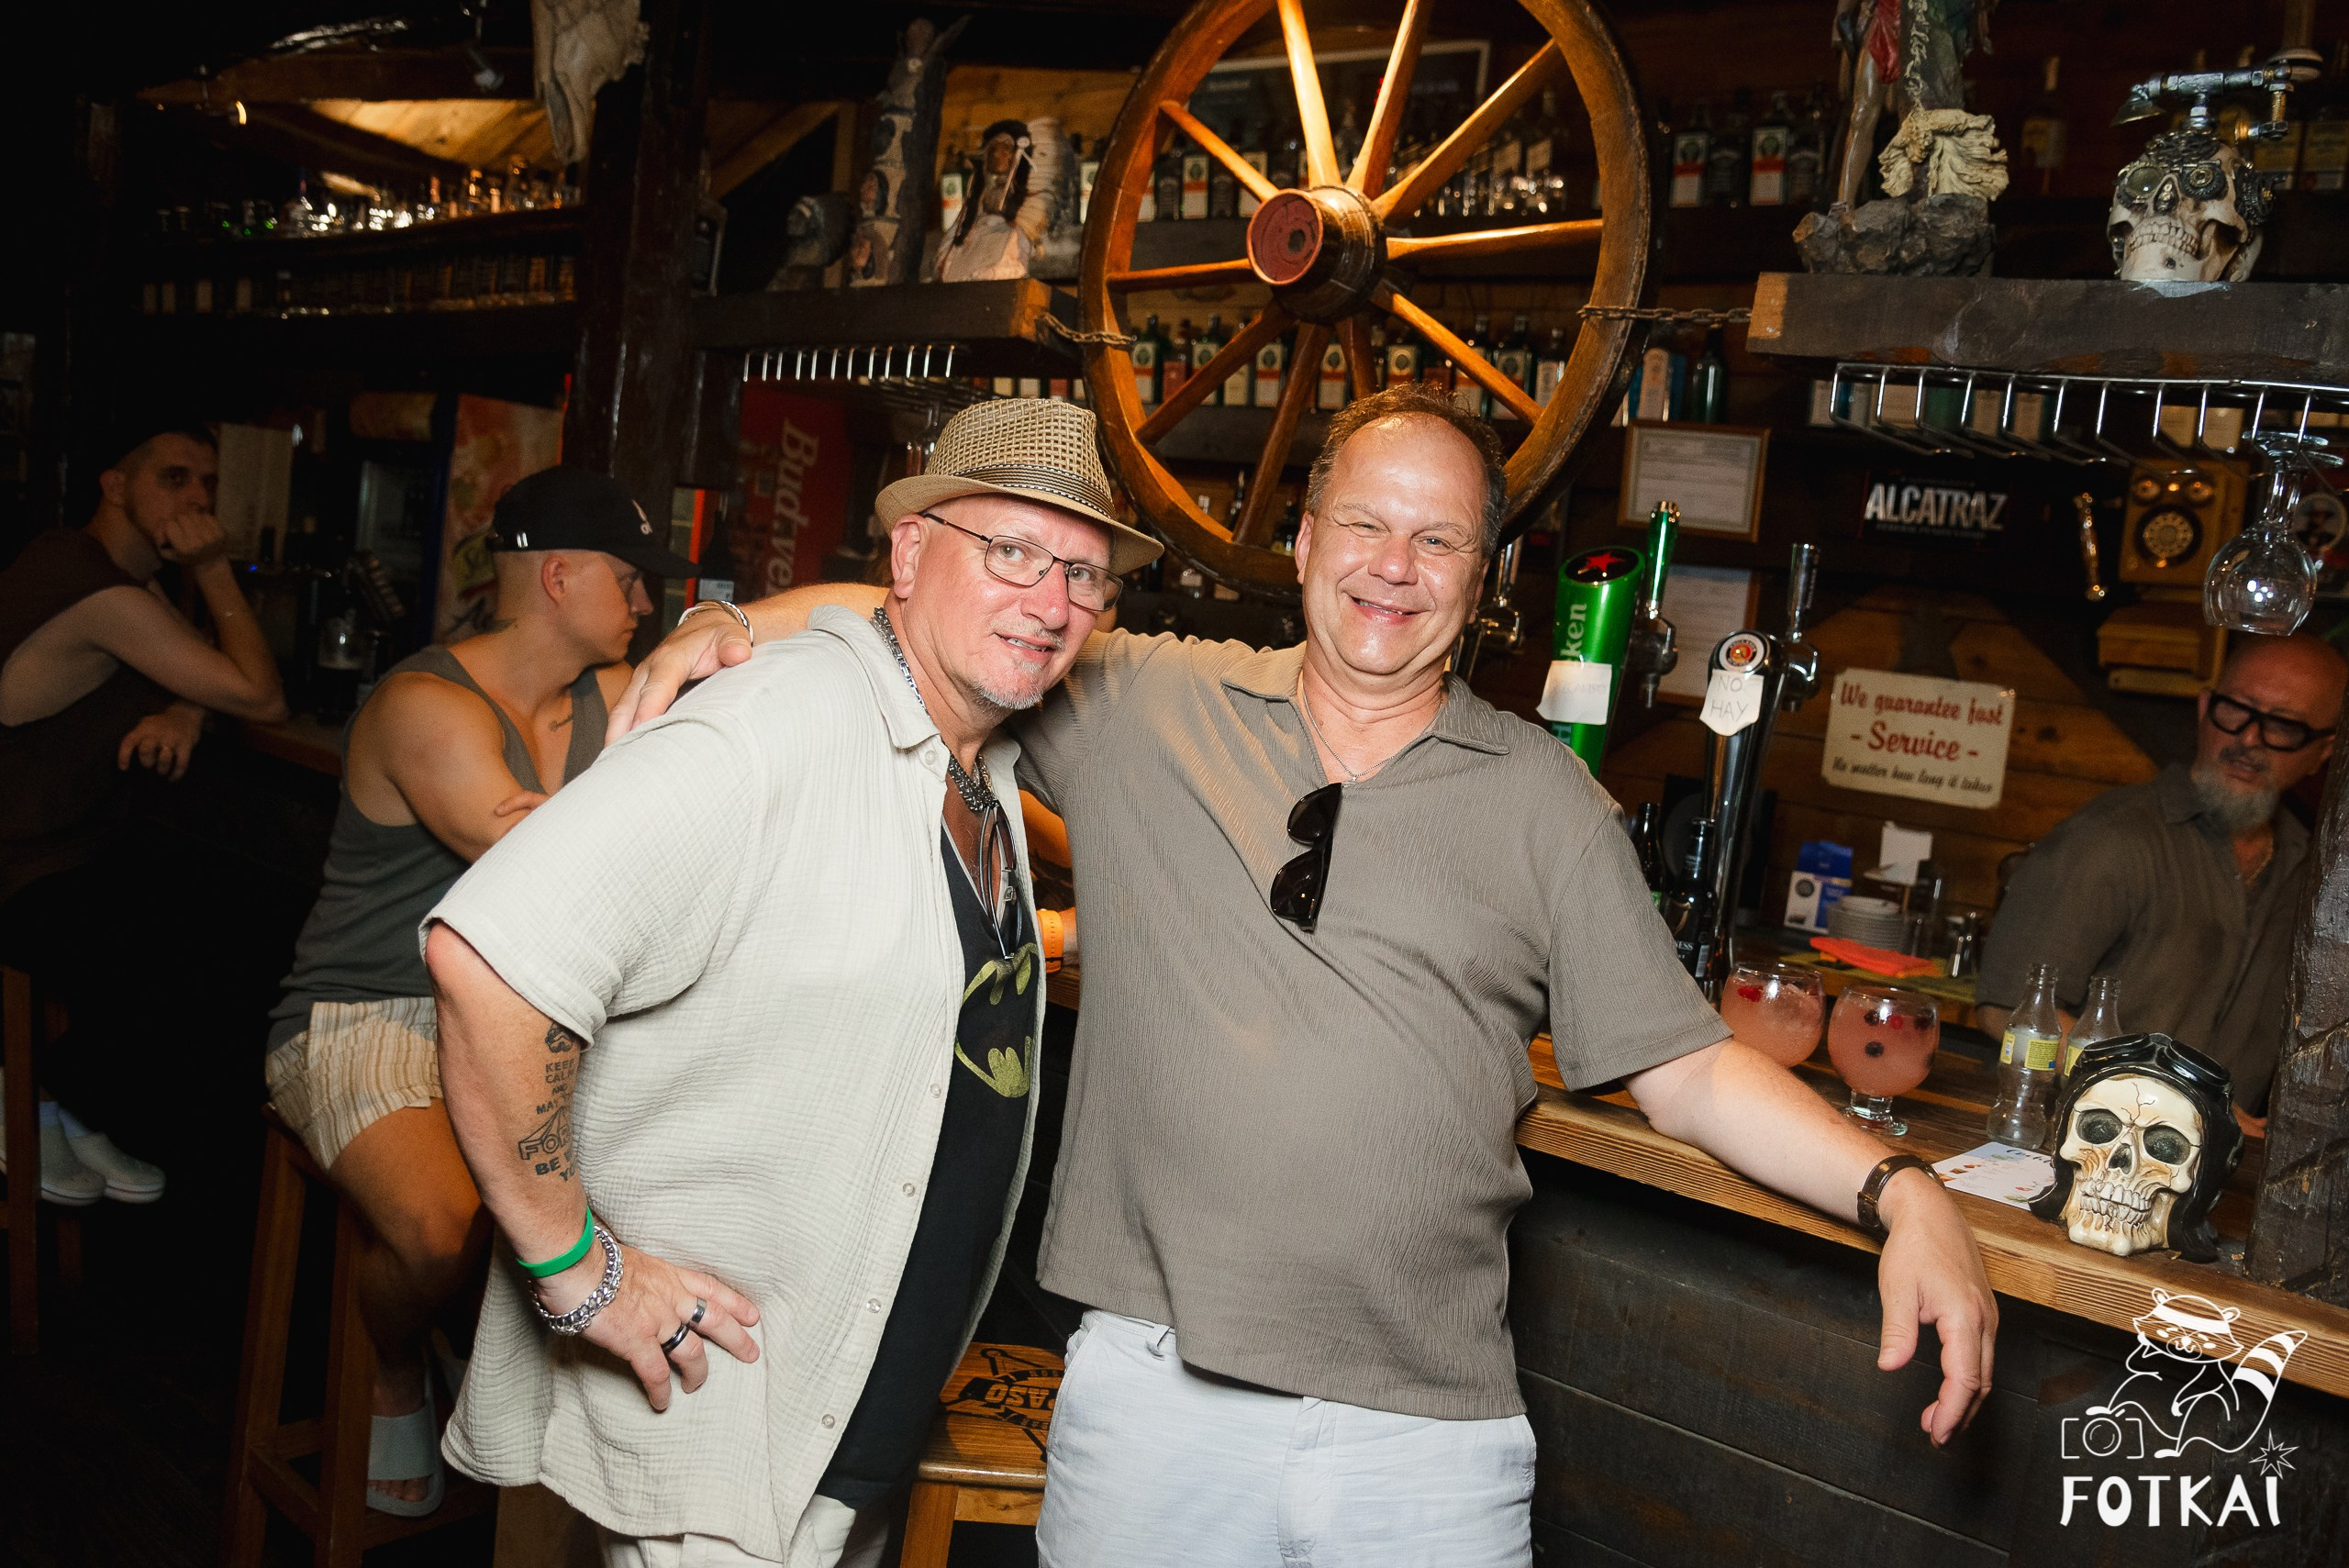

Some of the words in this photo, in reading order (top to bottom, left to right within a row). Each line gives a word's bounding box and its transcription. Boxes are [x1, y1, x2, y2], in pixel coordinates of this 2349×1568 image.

[1864, 483, 2009, 531] ALCATRAZ
[1717, 675, 1742, 693] NO
[1709, 699, 1749, 723] HAY
[1840, 681, 1868, 708] We
[1874, 694, 1961, 719] guarantee
[1966, 696, 2004, 726] fast
[1867, 719, 1962, 761] Service
[535, 1156, 561, 1175] BE
